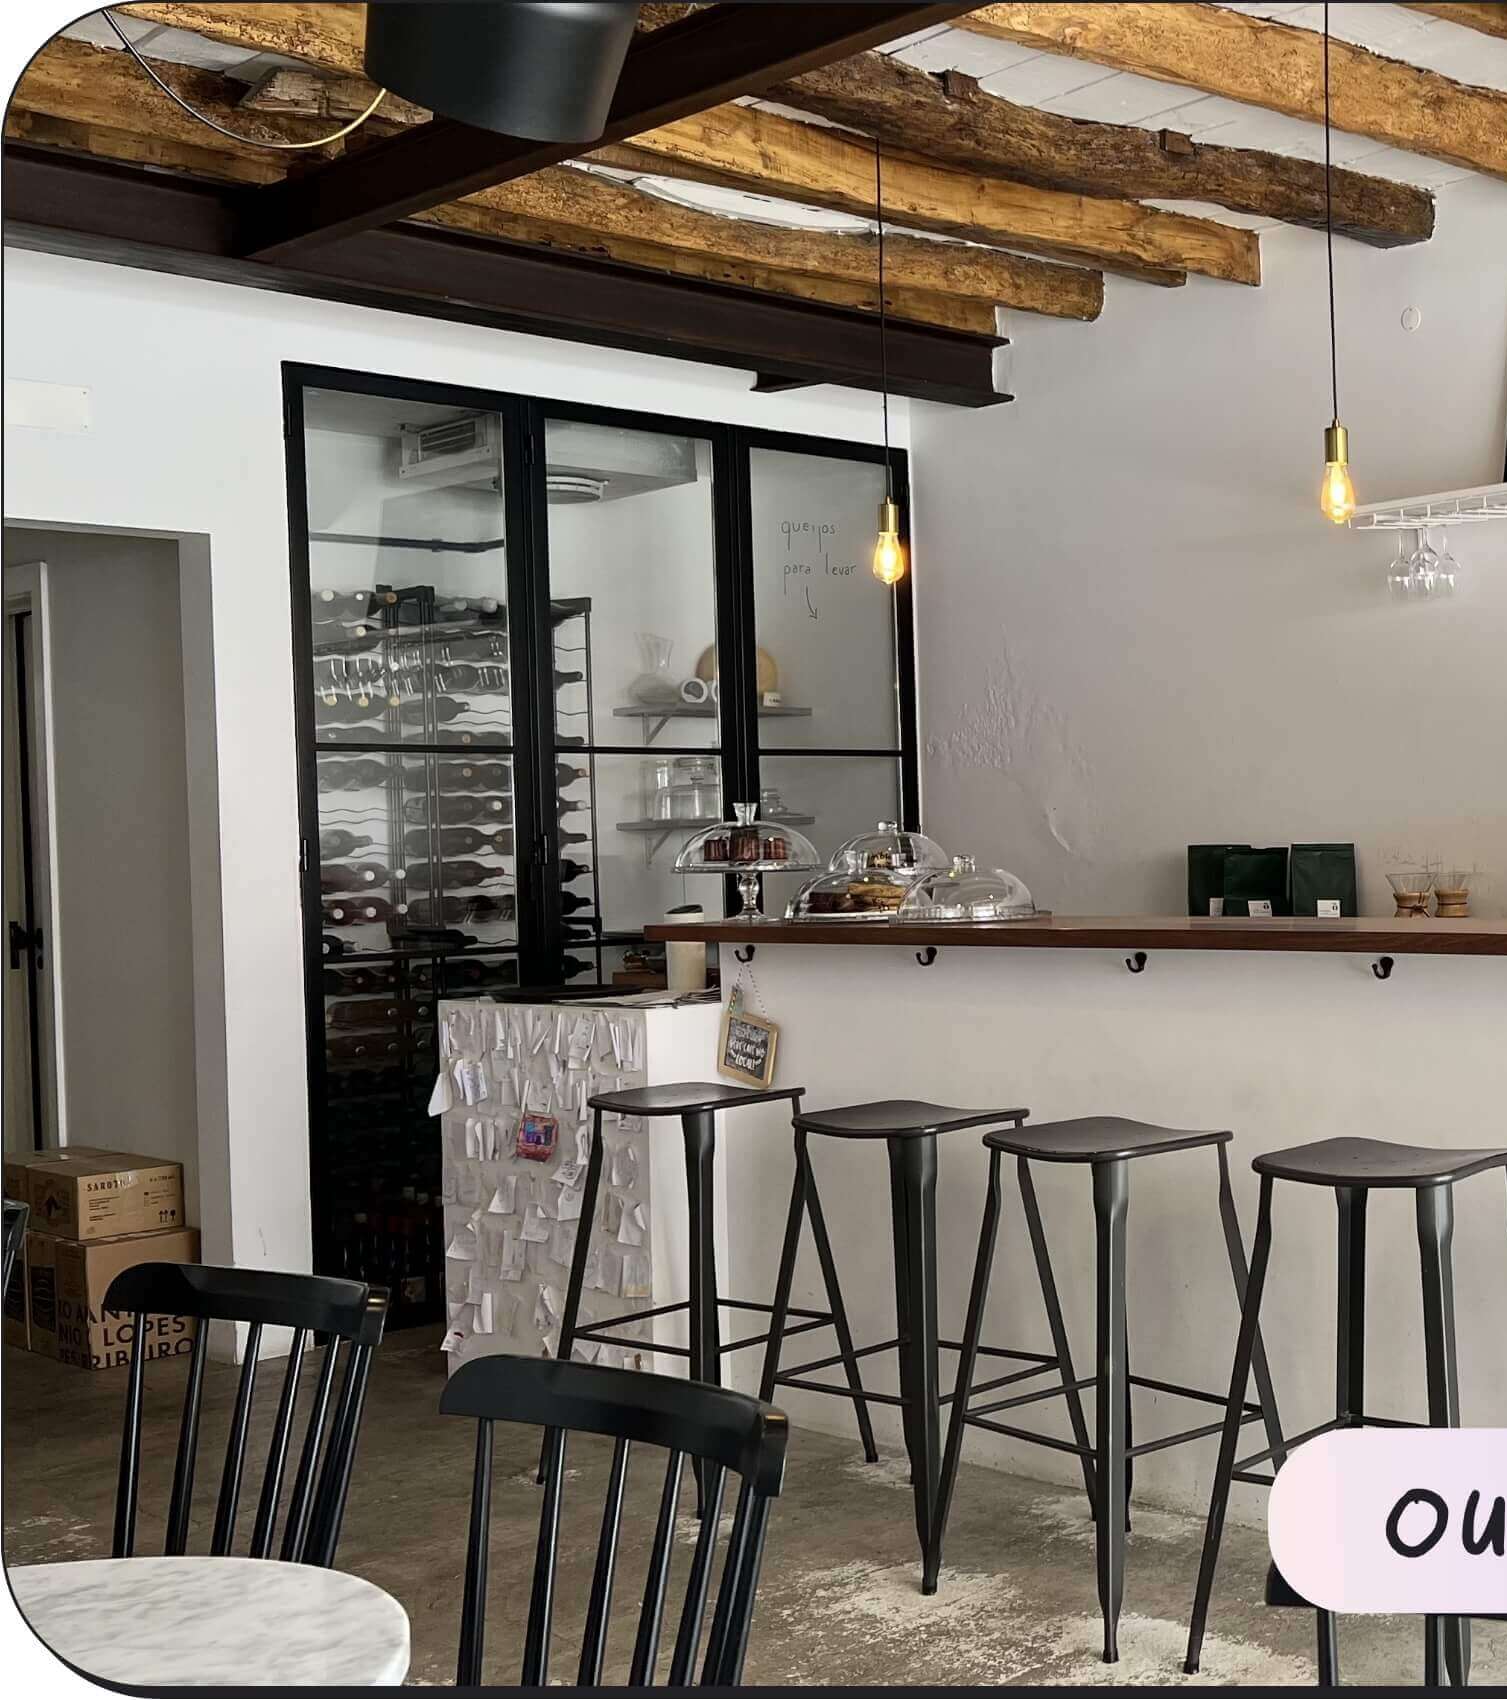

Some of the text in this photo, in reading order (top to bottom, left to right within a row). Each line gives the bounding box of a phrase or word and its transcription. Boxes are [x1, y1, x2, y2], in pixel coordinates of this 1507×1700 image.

[781, 521, 836, 552] queijos
[784, 552, 857, 595] para levar
[91, 1338, 195, 1371] RIBIRO
